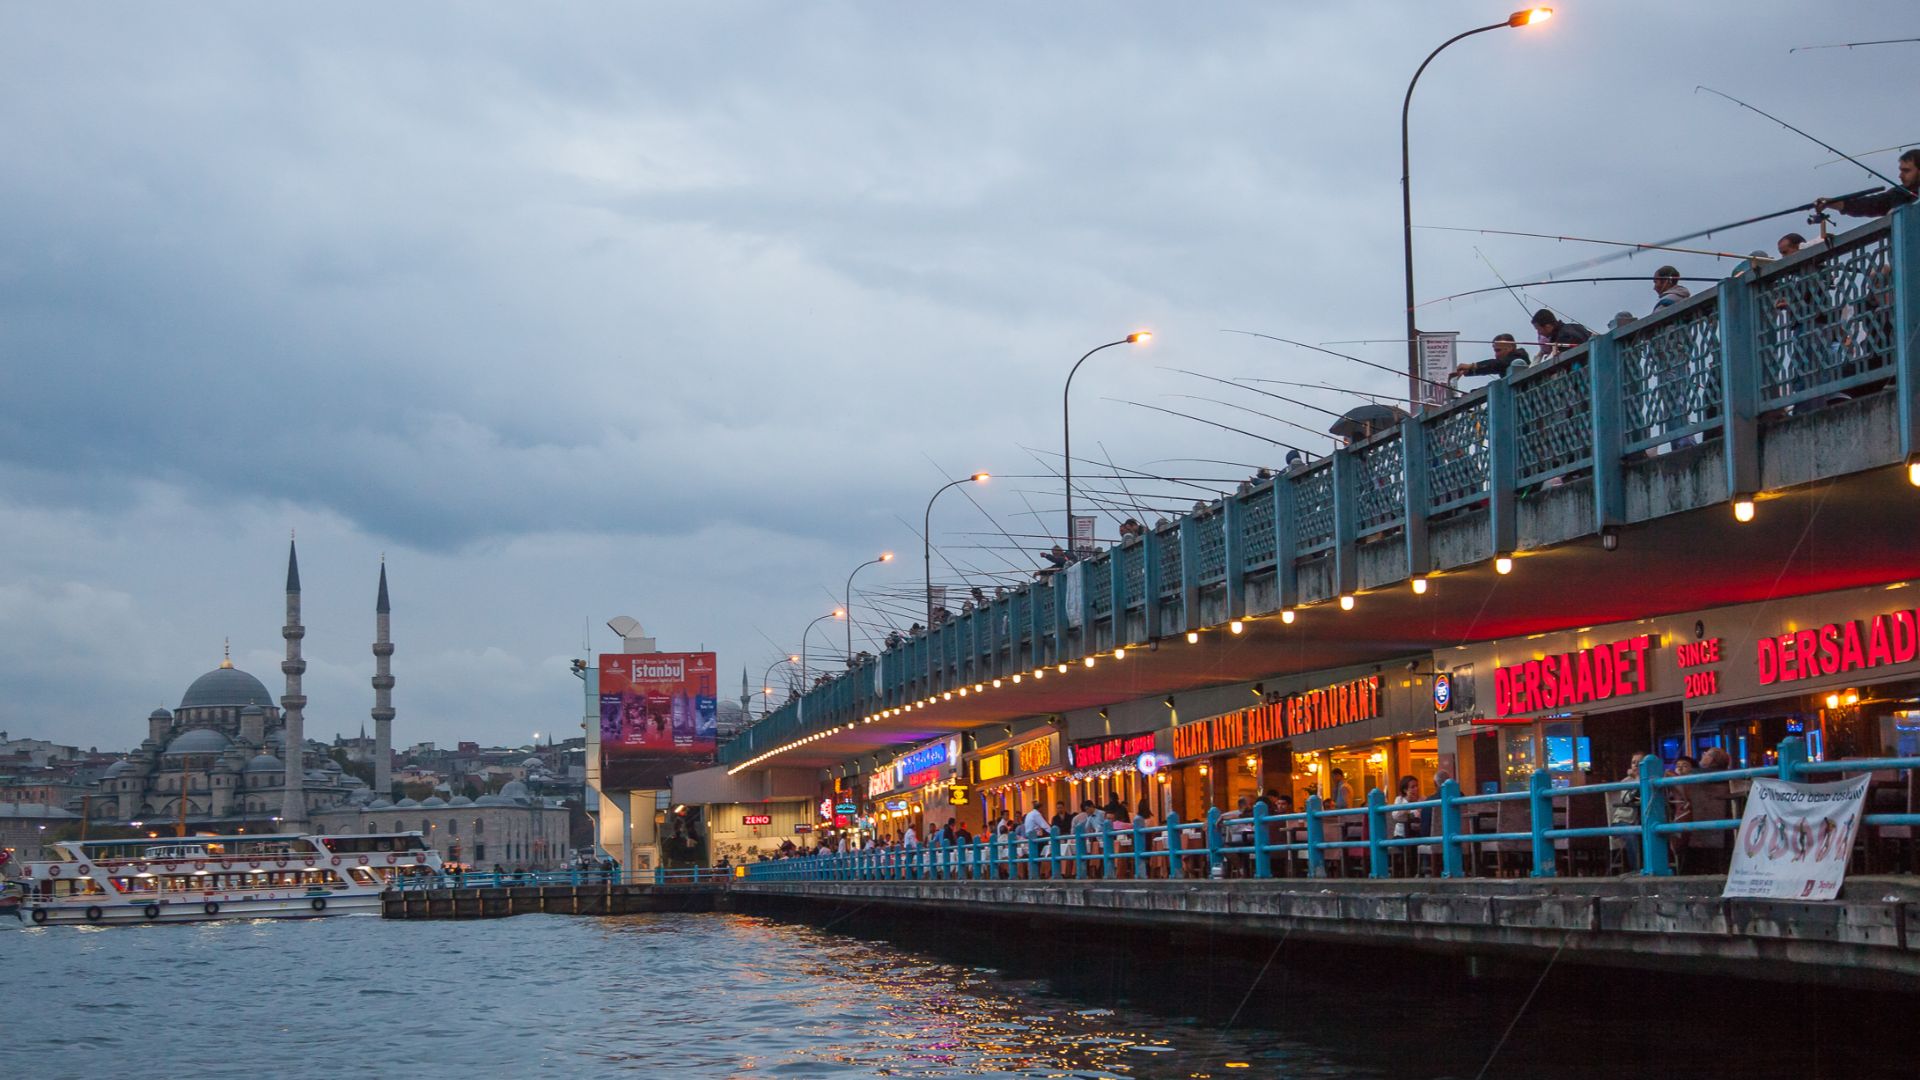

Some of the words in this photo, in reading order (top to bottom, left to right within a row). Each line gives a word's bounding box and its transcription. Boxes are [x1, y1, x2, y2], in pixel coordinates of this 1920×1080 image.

[1677, 638, 1720, 668] SINCE
[1758, 608, 1920, 685] DERSAAD
[1495, 635, 1650, 717] DERSAADET
[1684, 671, 1718, 699] 2001
[1173, 721, 1209, 759] GALATA
[1213, 711, 1244, 751] ALTIN
[1248, 702, 1284, 745] BALIK
[1287, 676, 1379, 736] RESTAURANT
[745, 816, 770, 824] ZENO
